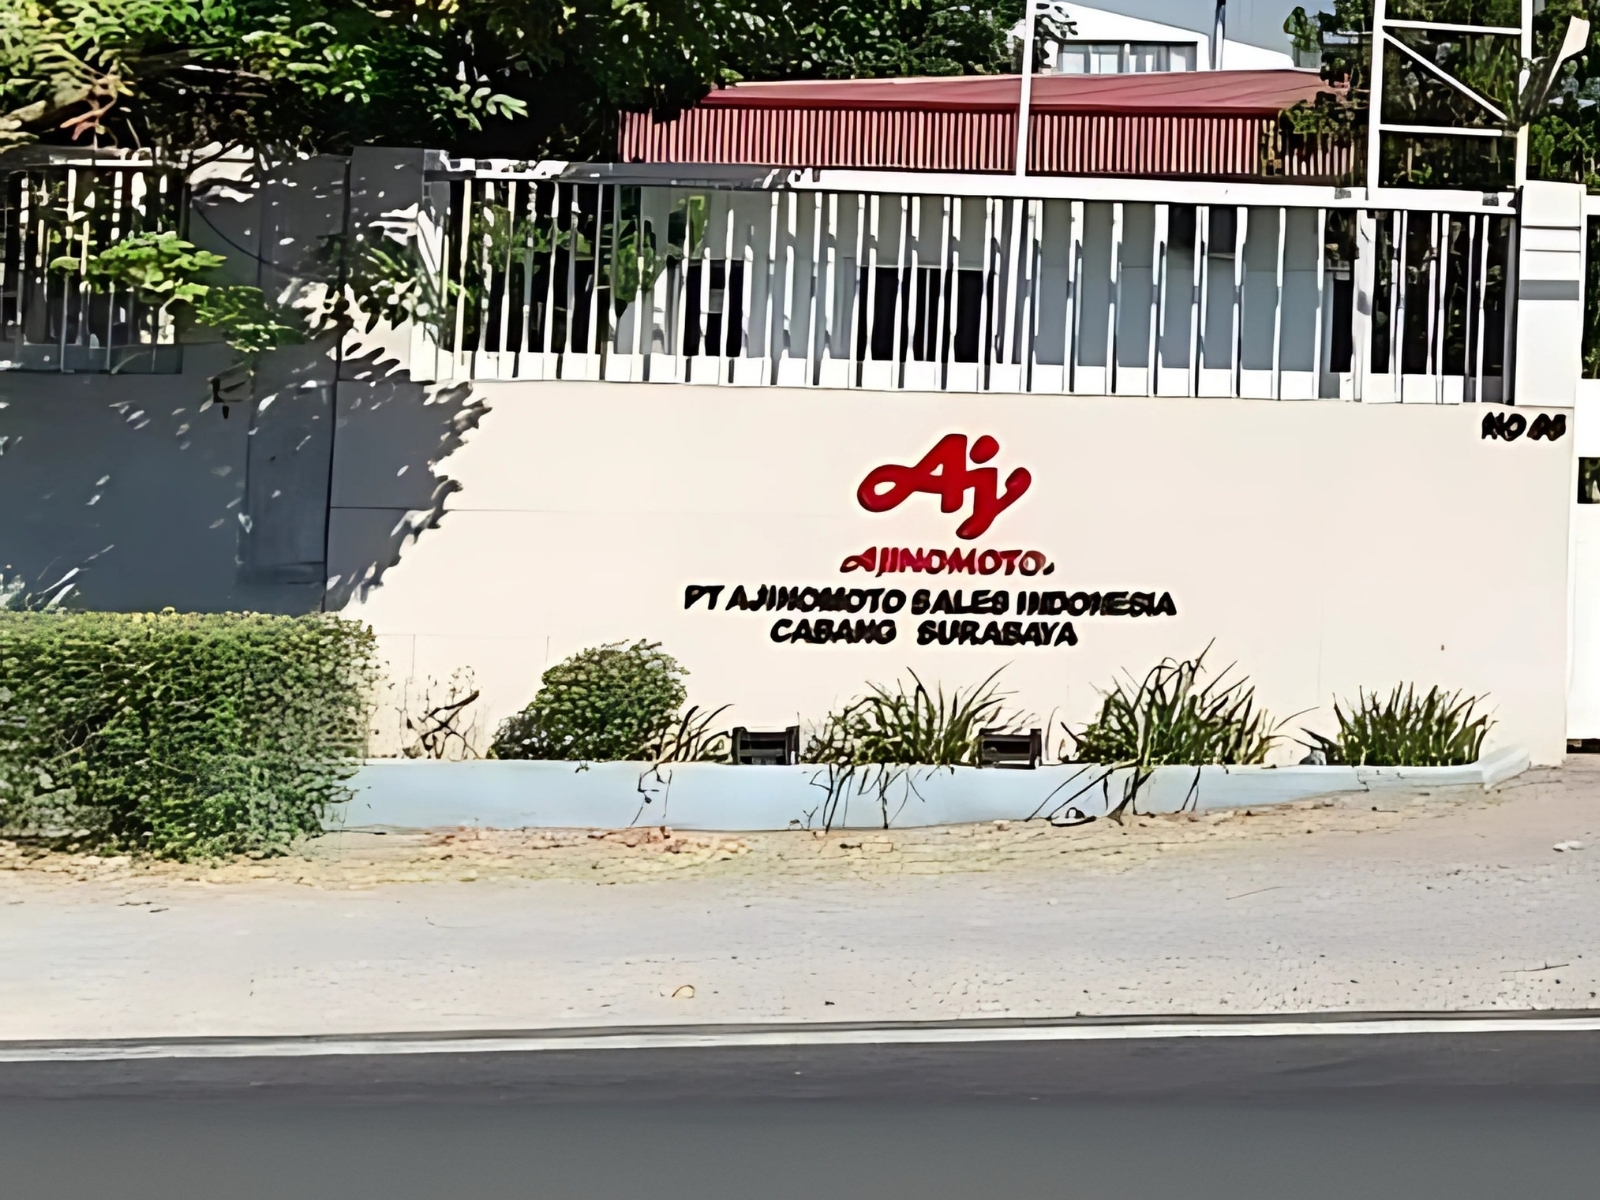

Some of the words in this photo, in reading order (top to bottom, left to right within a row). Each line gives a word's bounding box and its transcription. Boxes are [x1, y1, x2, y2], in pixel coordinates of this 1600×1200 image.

[683, 584, 726, 611] PT
[725, 584, 907, 614] AJINOMOTO
[910, 588, 1009, 616] SALES
[1016, 590, 1178, 618] INDONESIA
[769, 618, 897, 645] CABANG
[916, 619, 1079, 646] SURABAYA
